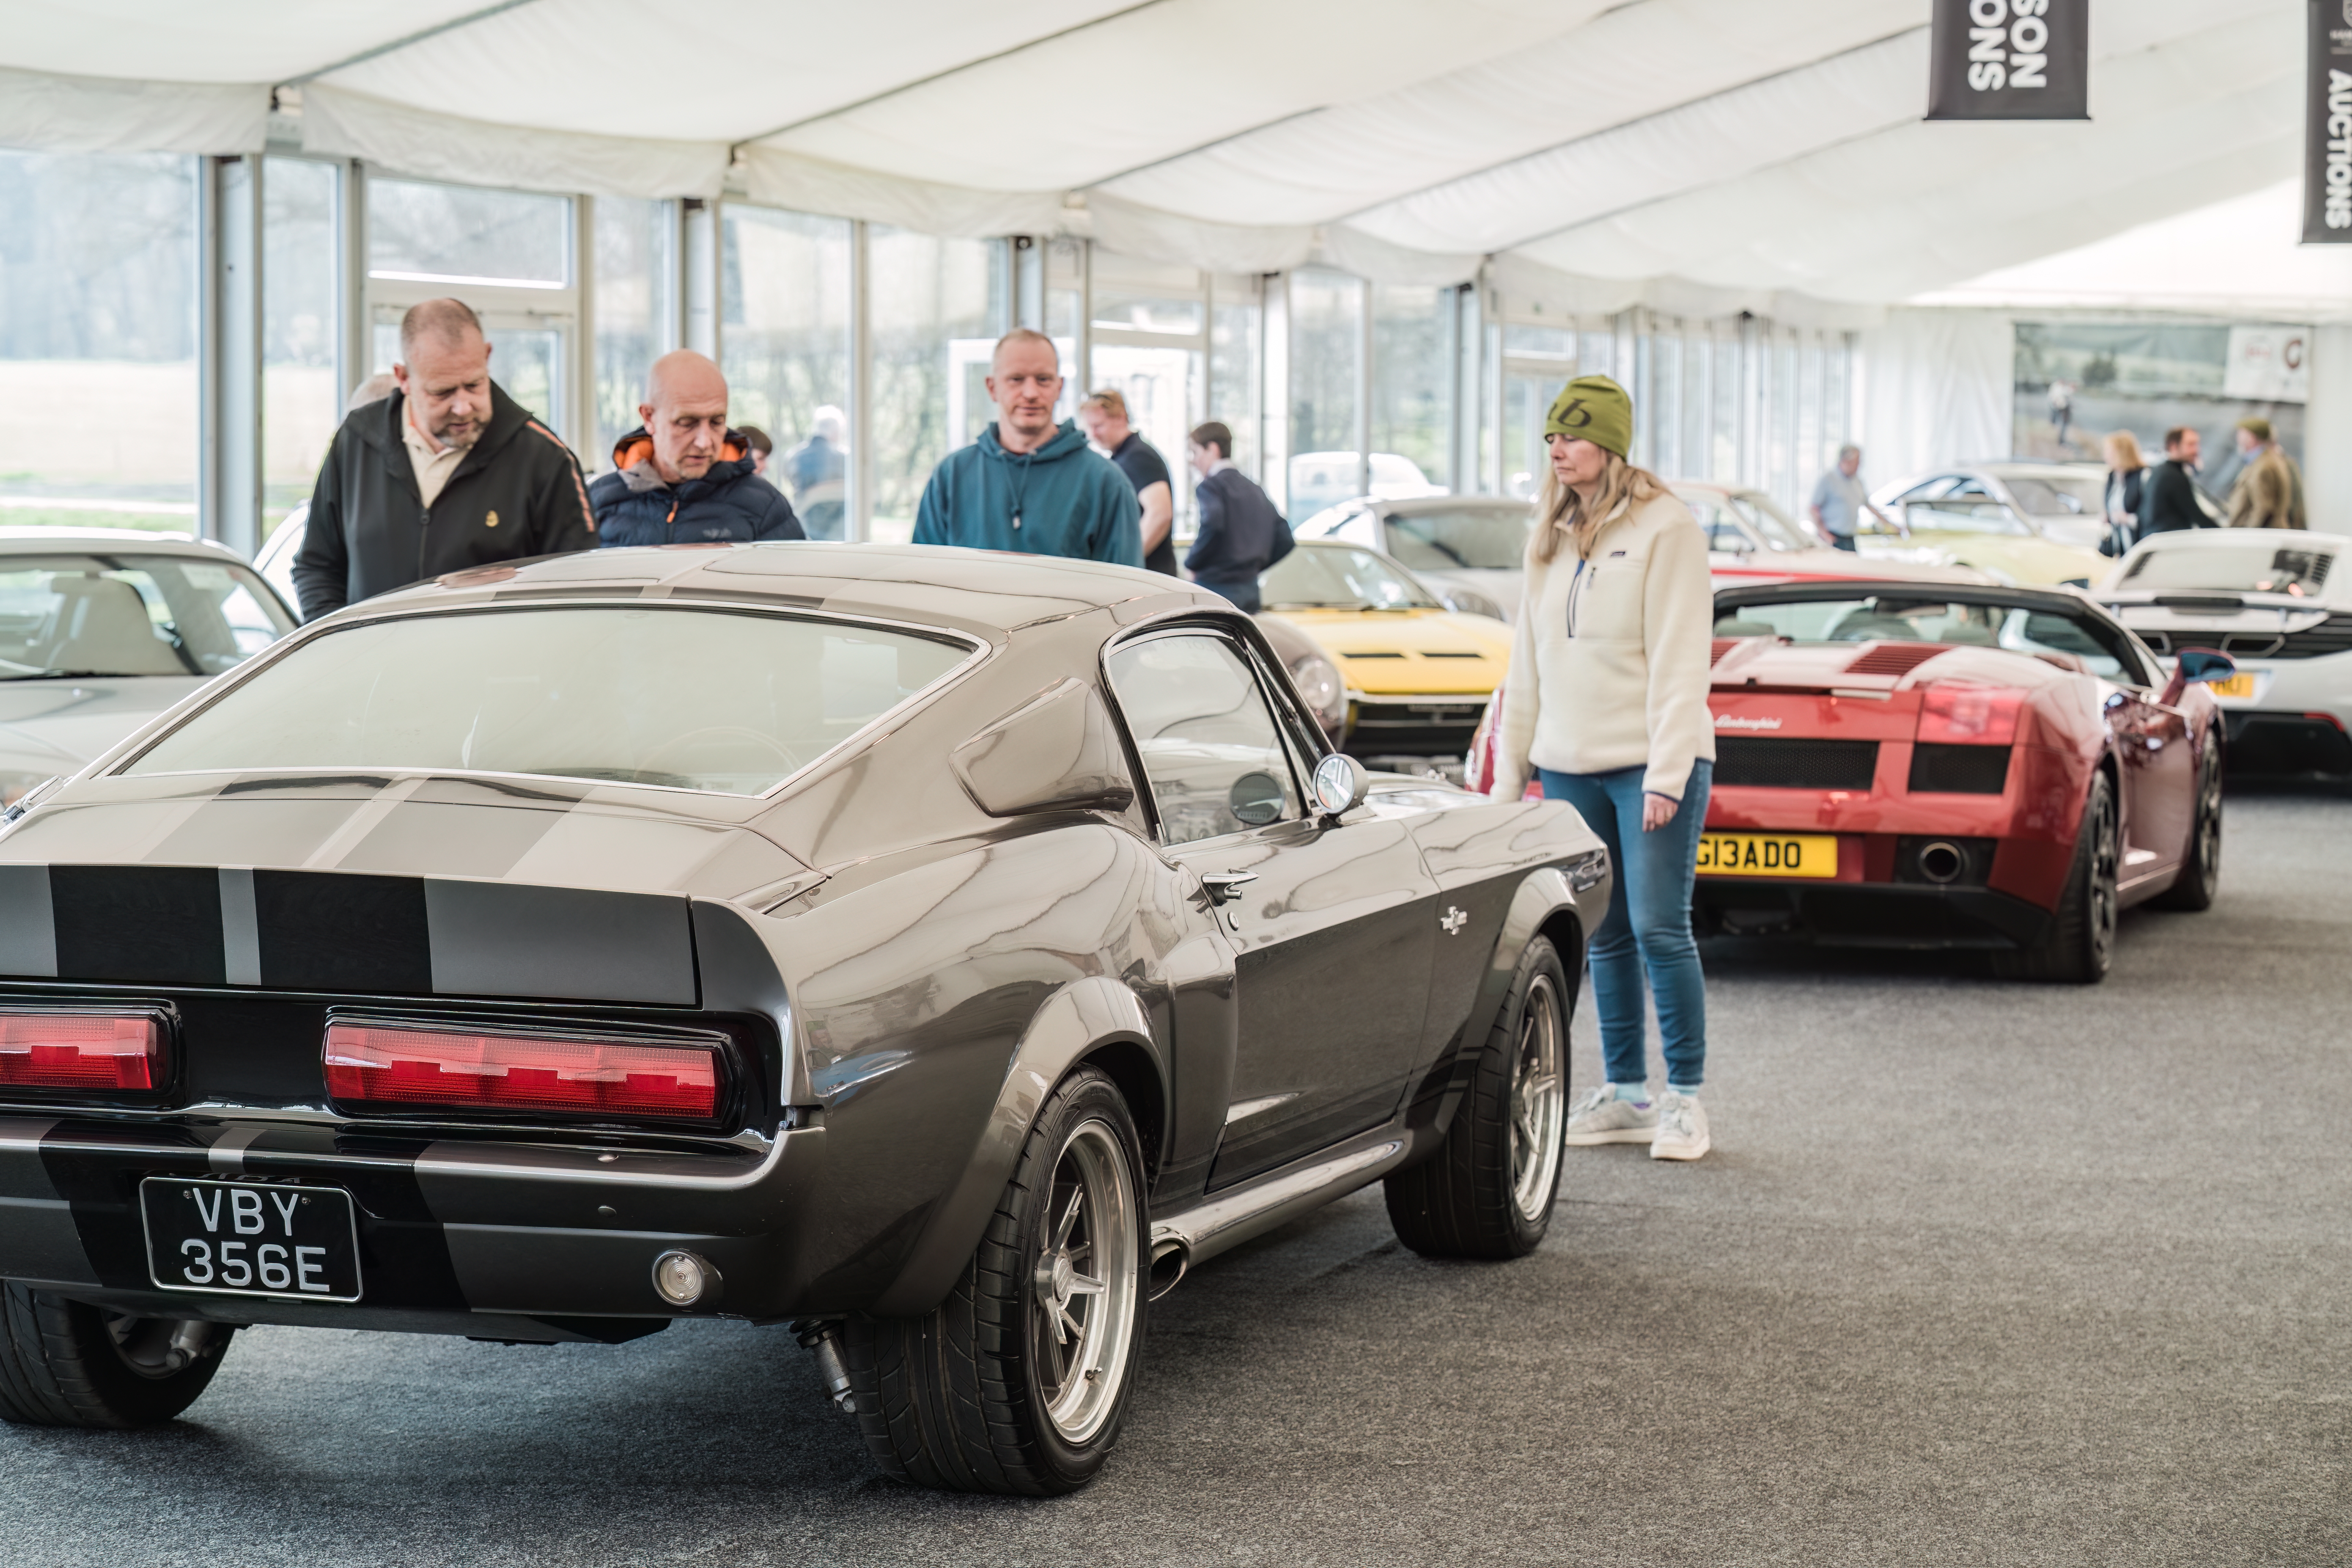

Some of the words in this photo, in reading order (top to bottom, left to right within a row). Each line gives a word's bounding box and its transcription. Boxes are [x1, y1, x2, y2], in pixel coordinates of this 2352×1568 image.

[1968, 0, 2008, 91] ONS
[2009, 0, 2049, 88] SON
[2325, 68, 2352, 229] AUCTIONS
[193, 1188, 299, 1236] VBY
[181, 1238, 330, 1292] 356E
